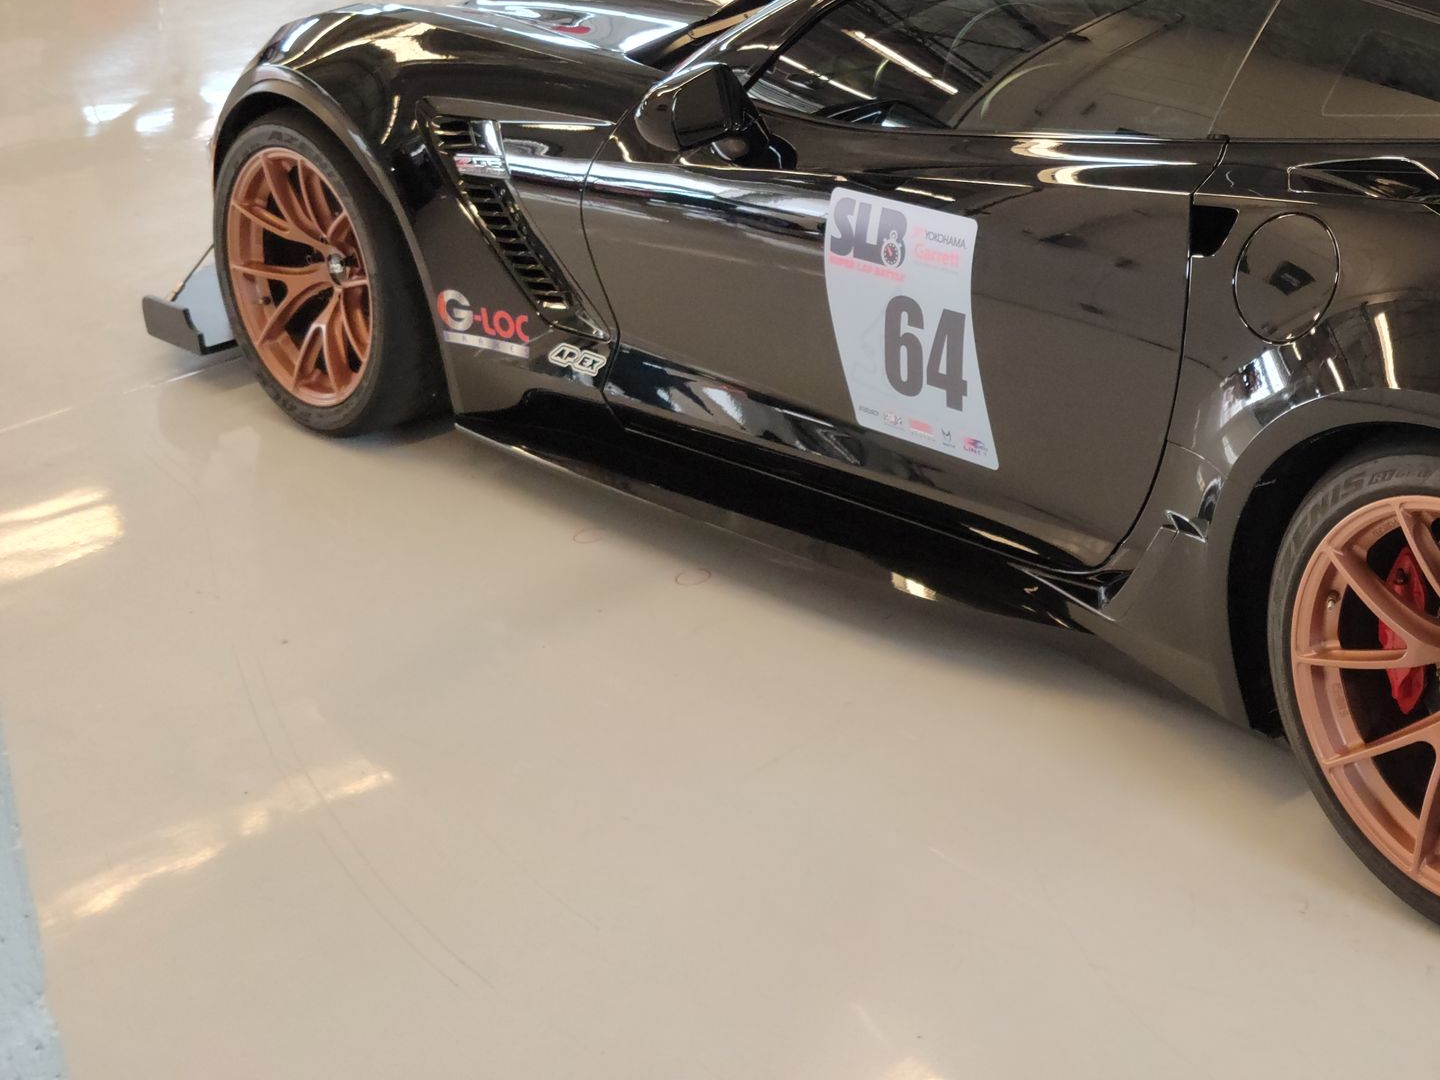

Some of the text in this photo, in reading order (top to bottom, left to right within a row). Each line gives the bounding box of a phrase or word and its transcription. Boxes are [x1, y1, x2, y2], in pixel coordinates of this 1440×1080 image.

[830, 197, 908, 268] SLB
[925, 229, 967, 248] YOKOHAMA
[437, 289, 529, 342] G-LOC
[554, 346, 601, 370] APEX
[885, 295, 967, 411] 64
